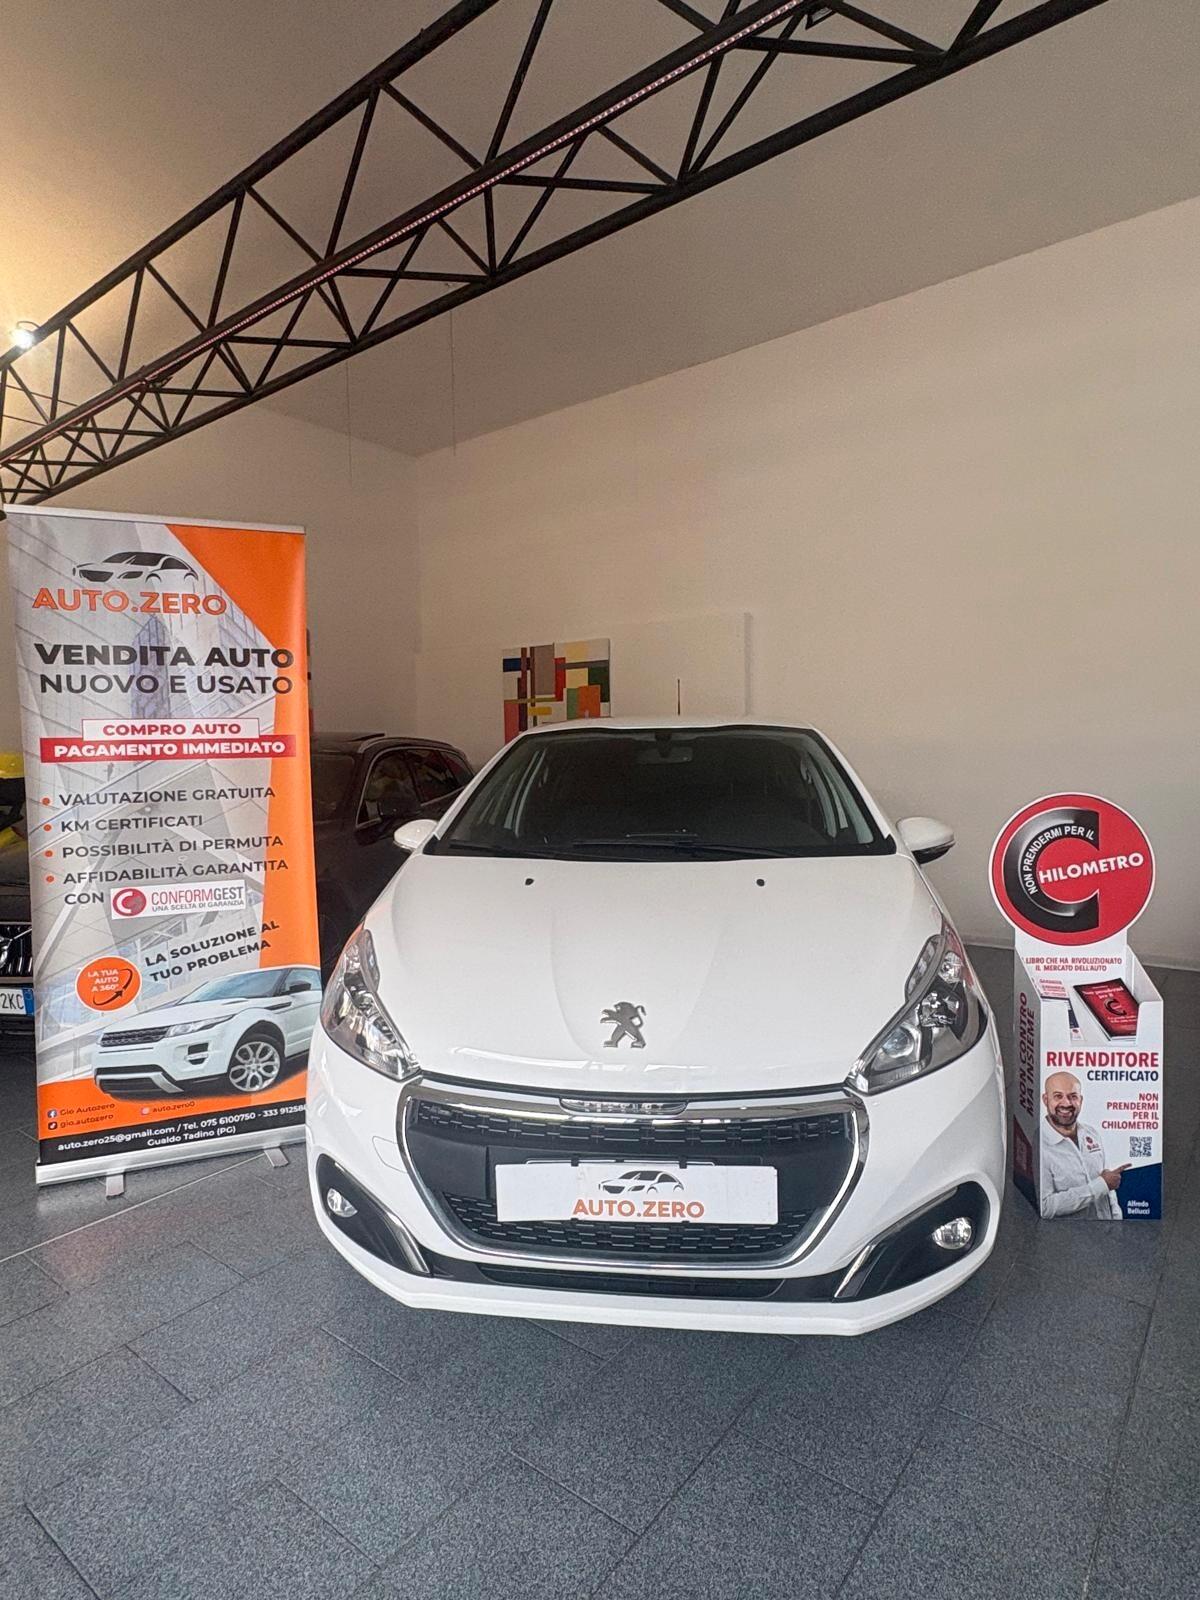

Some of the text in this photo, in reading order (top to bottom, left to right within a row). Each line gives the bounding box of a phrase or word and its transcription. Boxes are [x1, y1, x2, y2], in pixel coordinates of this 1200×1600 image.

[32, 587, 227, 615] AUTO.ZERO
[34, 643, 294, 667] VENDITA AUTO
[40, 674, 293, 694] NUOVO E USATO
[103, 723, 241, 736] COMPRO AUTO
[54, 741, 285, 757] PAGAMENTO IMMEDIATO
[59, 786, 276, 806] VALUTAZIONE GRATUITA
[61, 815, 202, 832] KM CERTIFICATI
[62, 835, 284, 858] POSSIBILITÀ DI PERMUTA
[1023, 826, 1095, 895] NON PRENDERMI PER IL
[63, 859, 289, 884] AFFIDABILITÀ GARANTITA
[64, 887, 243, 905] CON CONFORMGEST
[171, 903, 197, 911] SCELTA
[145, 920, 280, 967] LA SOLUZIONE AL
[149, 939, 272, 982] TUO PROBLEMA
[1027, 1008, 1035, 1117] MA INSIEME
[1046, 1051, 1159, 1067] RIVENDITORE
[1087, 1070, 1159, 1082] CERTIFICATO
[1107, 1102, 1159, 1110] PRENDERMI
[1139, 1093, 1158, 1101] NON
[58, 1126, 175, 1150] auto.zero25@gmail.com
[200, 1118, 217, 1127] 075
[219, 1112, 256, 1125] 6100750
[263, 1109, 278, 1118] 333
[1101, 1121, 1159, 1129] CHILOMETRO
[147, 1126, 236, 1146] Gualdo Tadino (PG)
[572, 1199, 704, 1218] AUTO.ZERO
